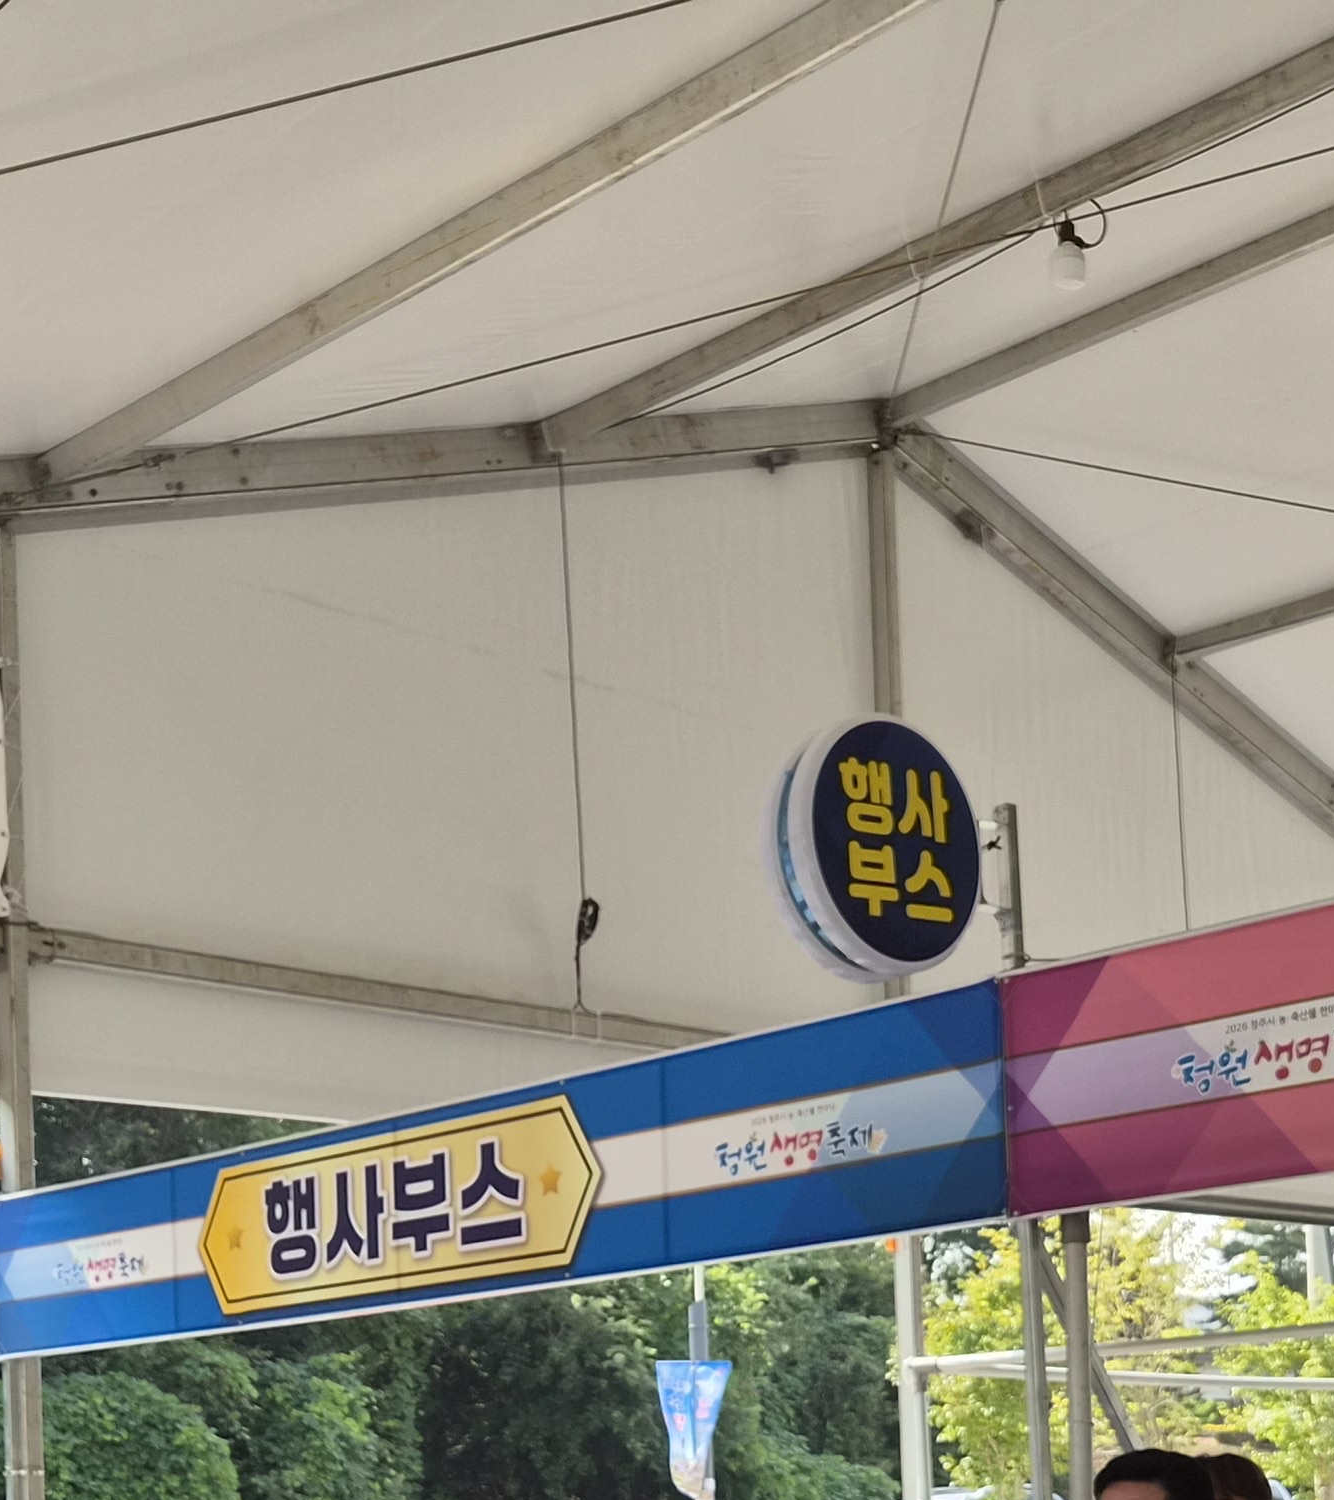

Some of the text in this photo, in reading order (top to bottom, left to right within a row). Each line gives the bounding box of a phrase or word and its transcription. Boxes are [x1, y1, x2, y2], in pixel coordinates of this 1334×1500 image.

[838, 756, 951, 845] 행사
[848, 838, 955, 924] 부스
[1225, 1023, 1247, 1034] 2026
[1251, 1016, 1276, 1031] 청주시
[264, 1141, 524, 1275] 행사부스
